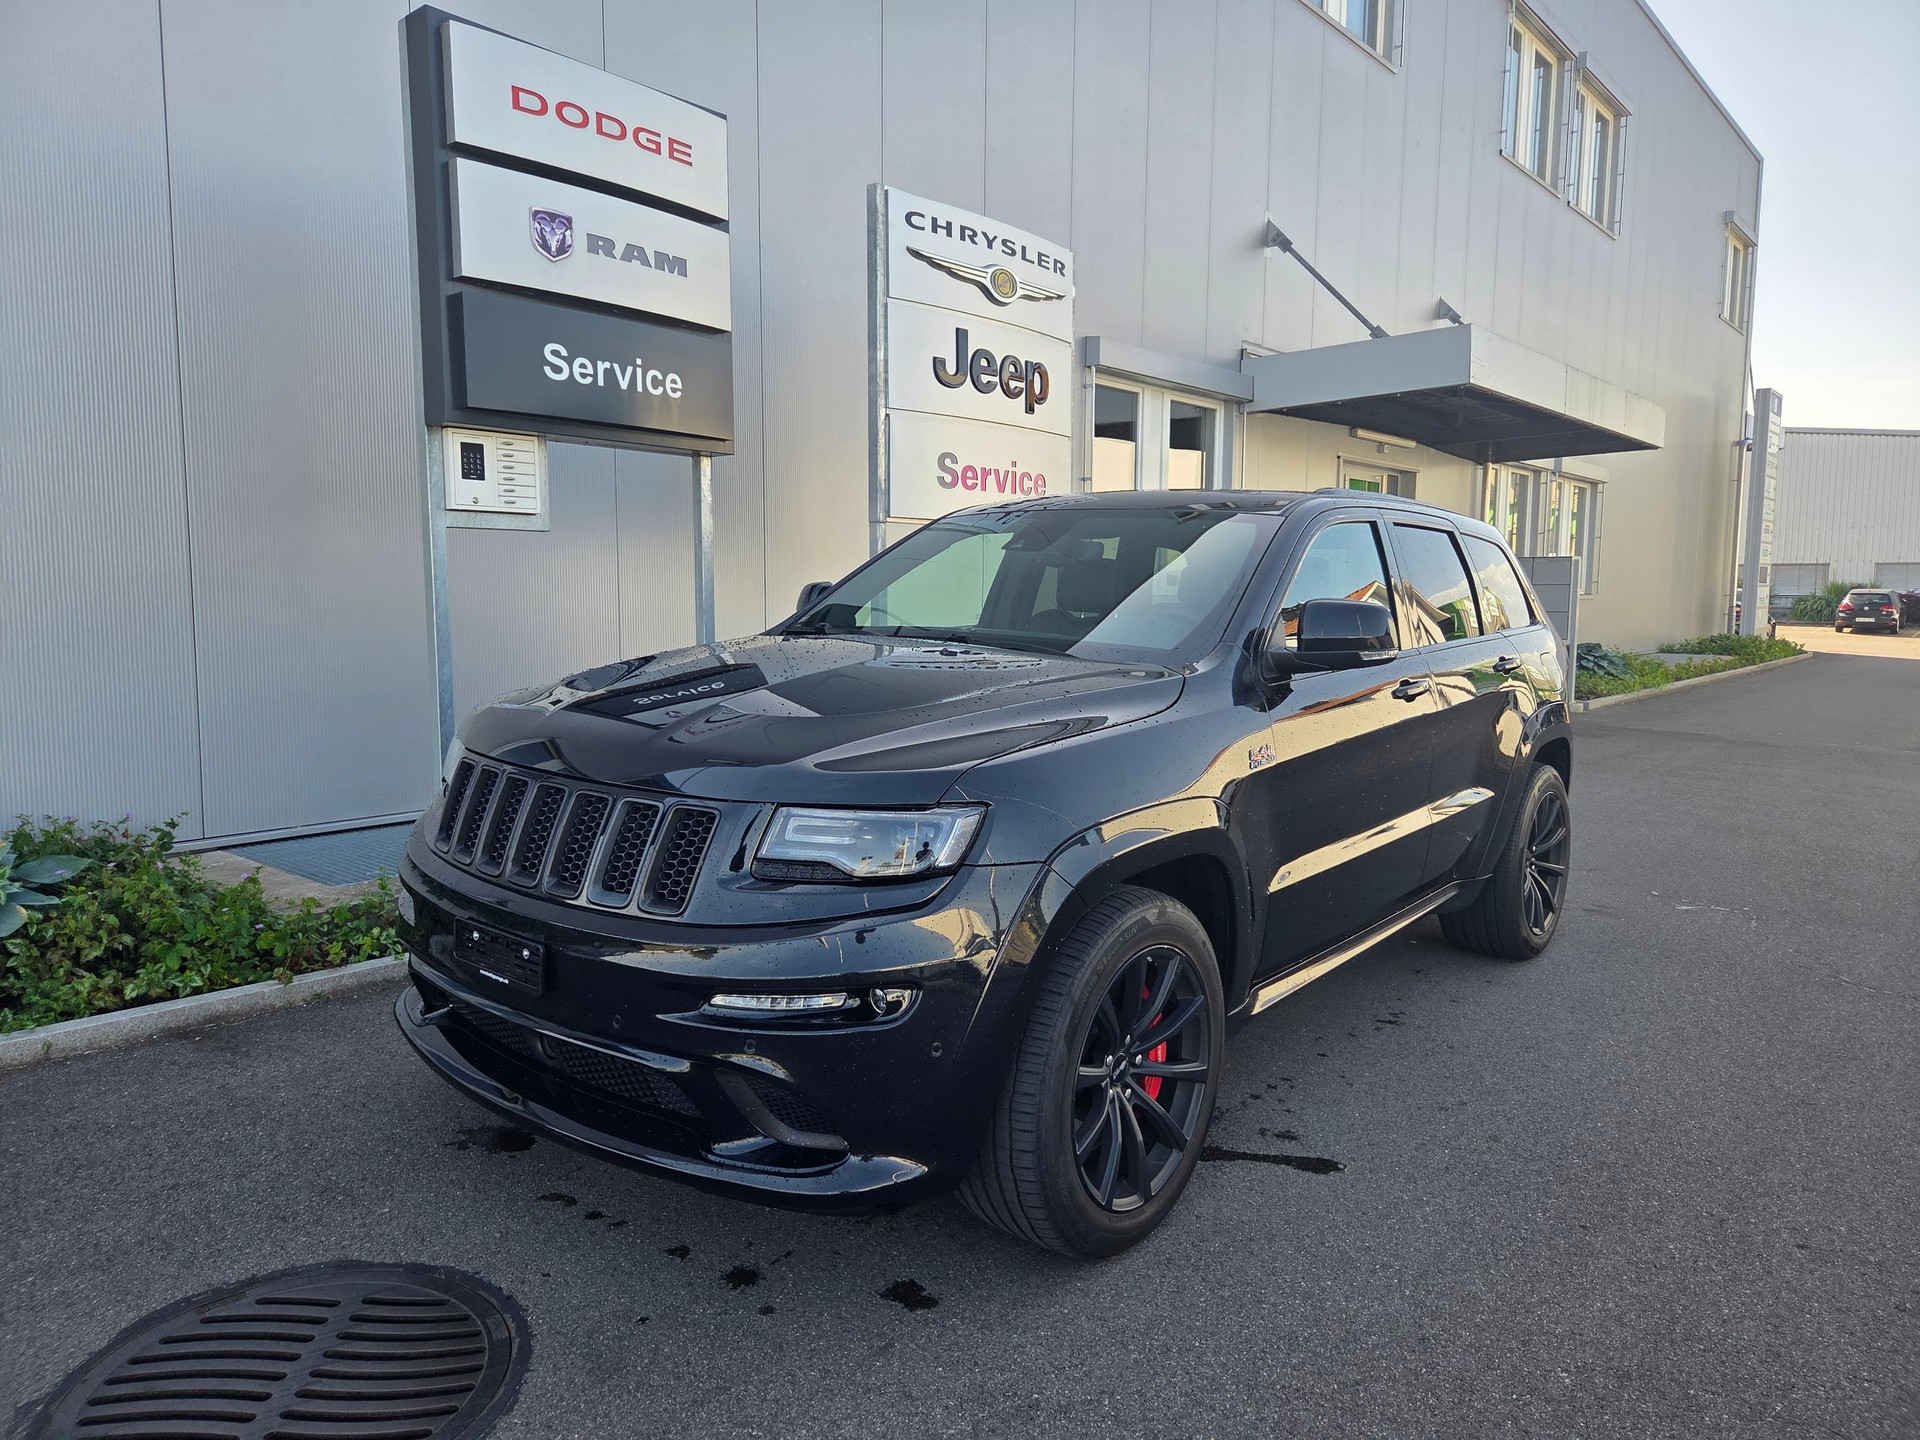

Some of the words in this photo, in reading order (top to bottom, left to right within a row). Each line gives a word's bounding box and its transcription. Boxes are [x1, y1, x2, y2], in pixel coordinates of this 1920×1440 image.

[511, 85, 693, 167] DODGE
[586, 233, 688, 278] RAM
[904, 211, 1066, 277] CHRYSLER
[543, 343, 683, 399] Service
[932, 327, 1050, 415] Jeep
[936, 451, 1047, 496] Service
